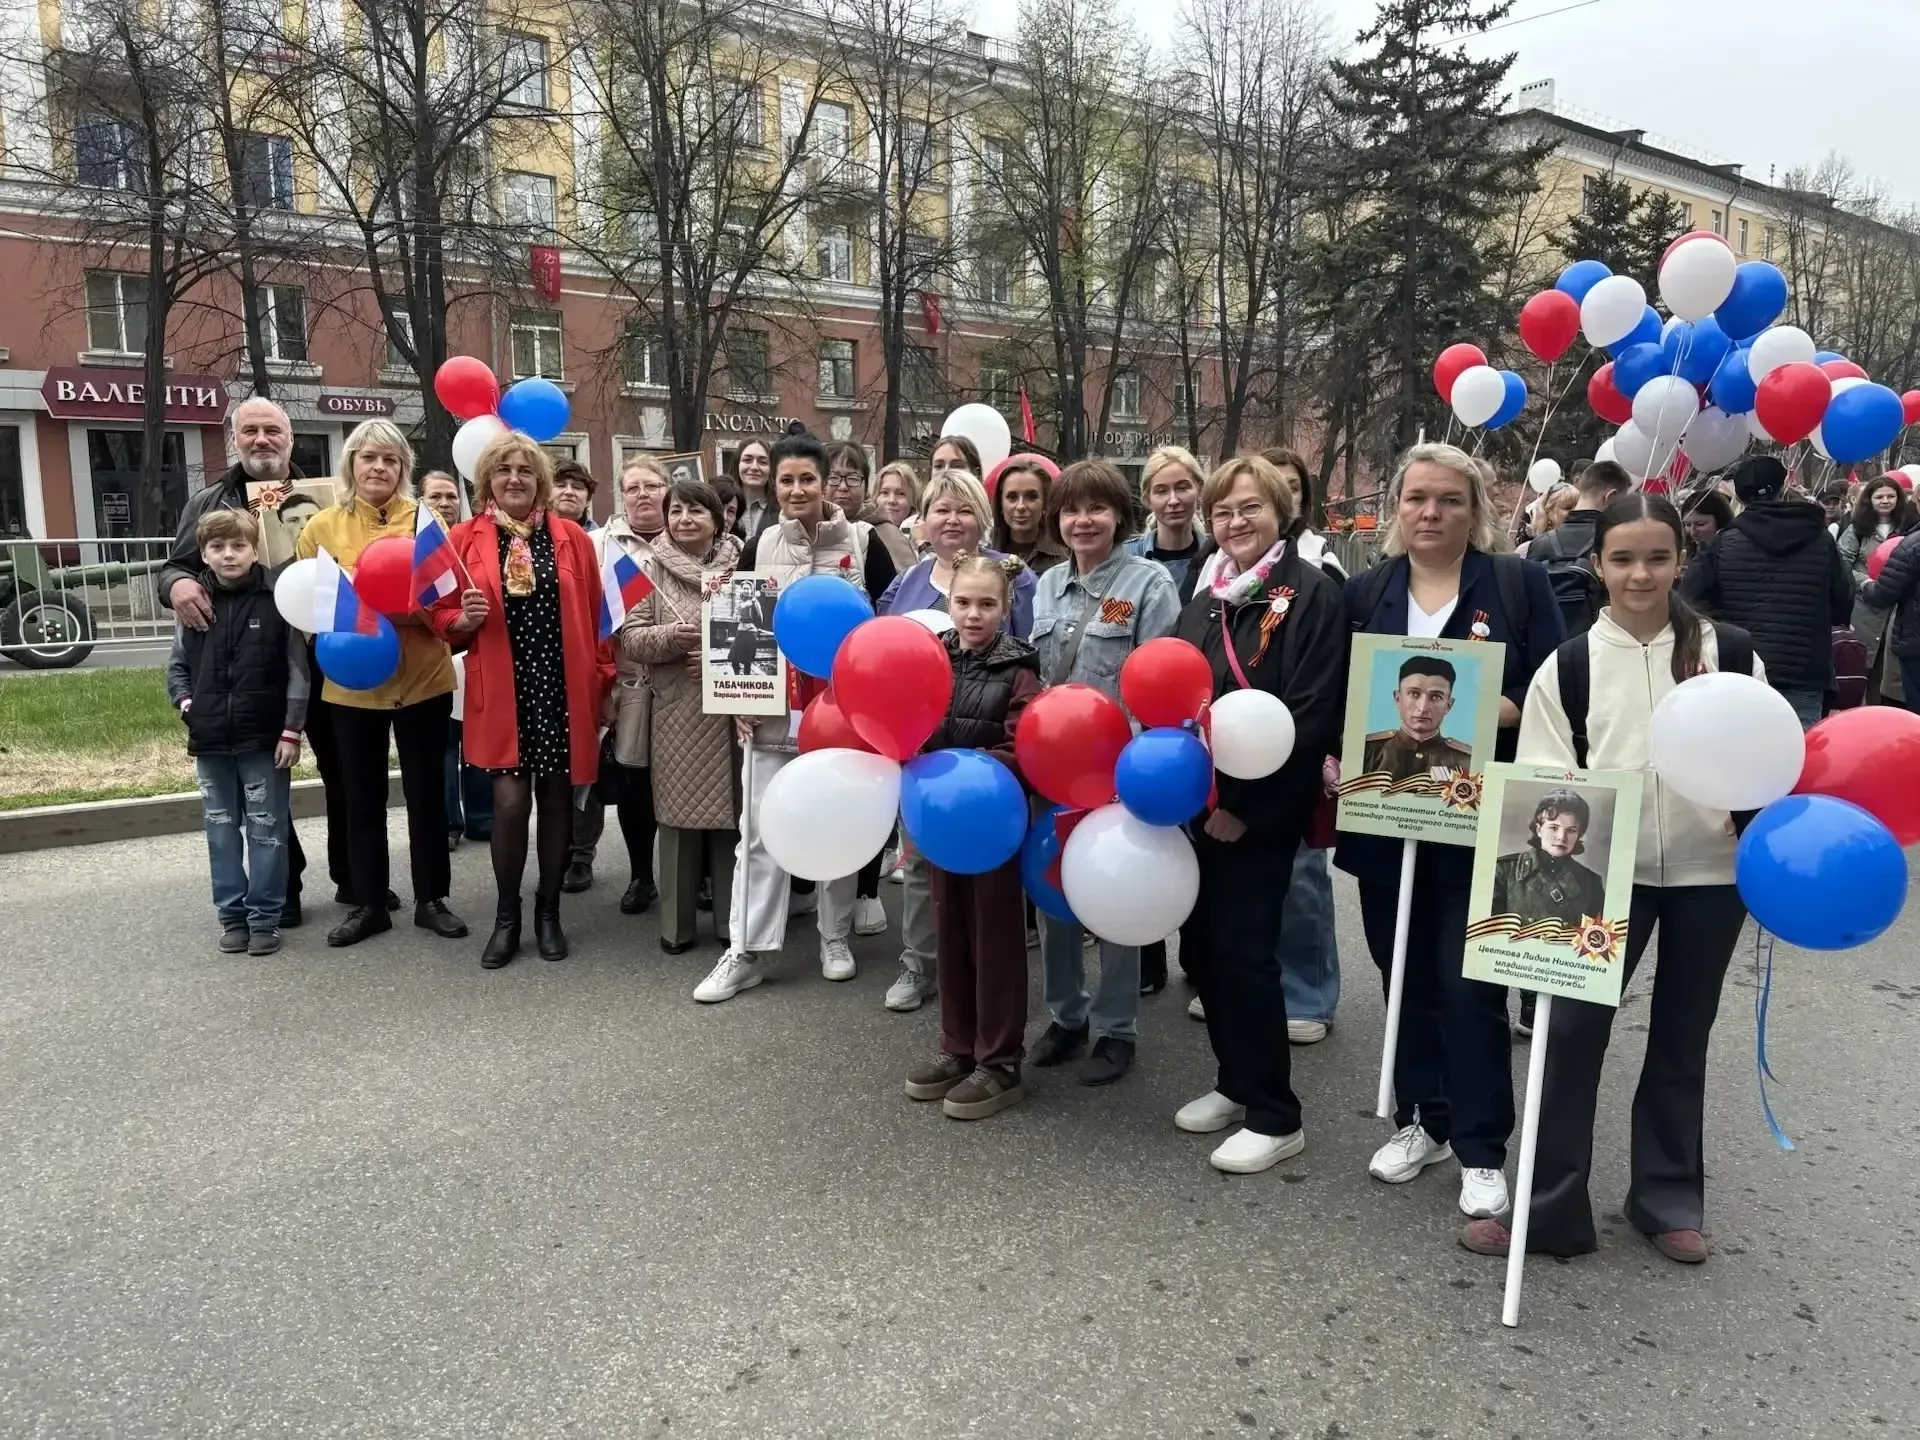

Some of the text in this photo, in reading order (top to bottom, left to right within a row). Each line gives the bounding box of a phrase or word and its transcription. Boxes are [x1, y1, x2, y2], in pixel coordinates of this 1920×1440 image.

[328, 397, 387, 412] ОБУВЬ
[704, 413, 801, 433] INCANT
[713, 680, 775, 690] ТАБАЧИКОВА
[713, 691, 775, 700] Варвара Петровна
[1342, 799, 1379, 810] Цветков
[1381, 803, 1436, 817] Константин
[1344, 811, 1384, 821] командир
[1385, 815, 1442, 827] пограничного
[1398, 823, 1424, 832] майор
[1478, 944, 1607, 974] Цветкова Лидия Николаевна
[1493, 968, 1586, 989] медицинской службы
[1494, 960, 1586, 982] младший лейтенант
